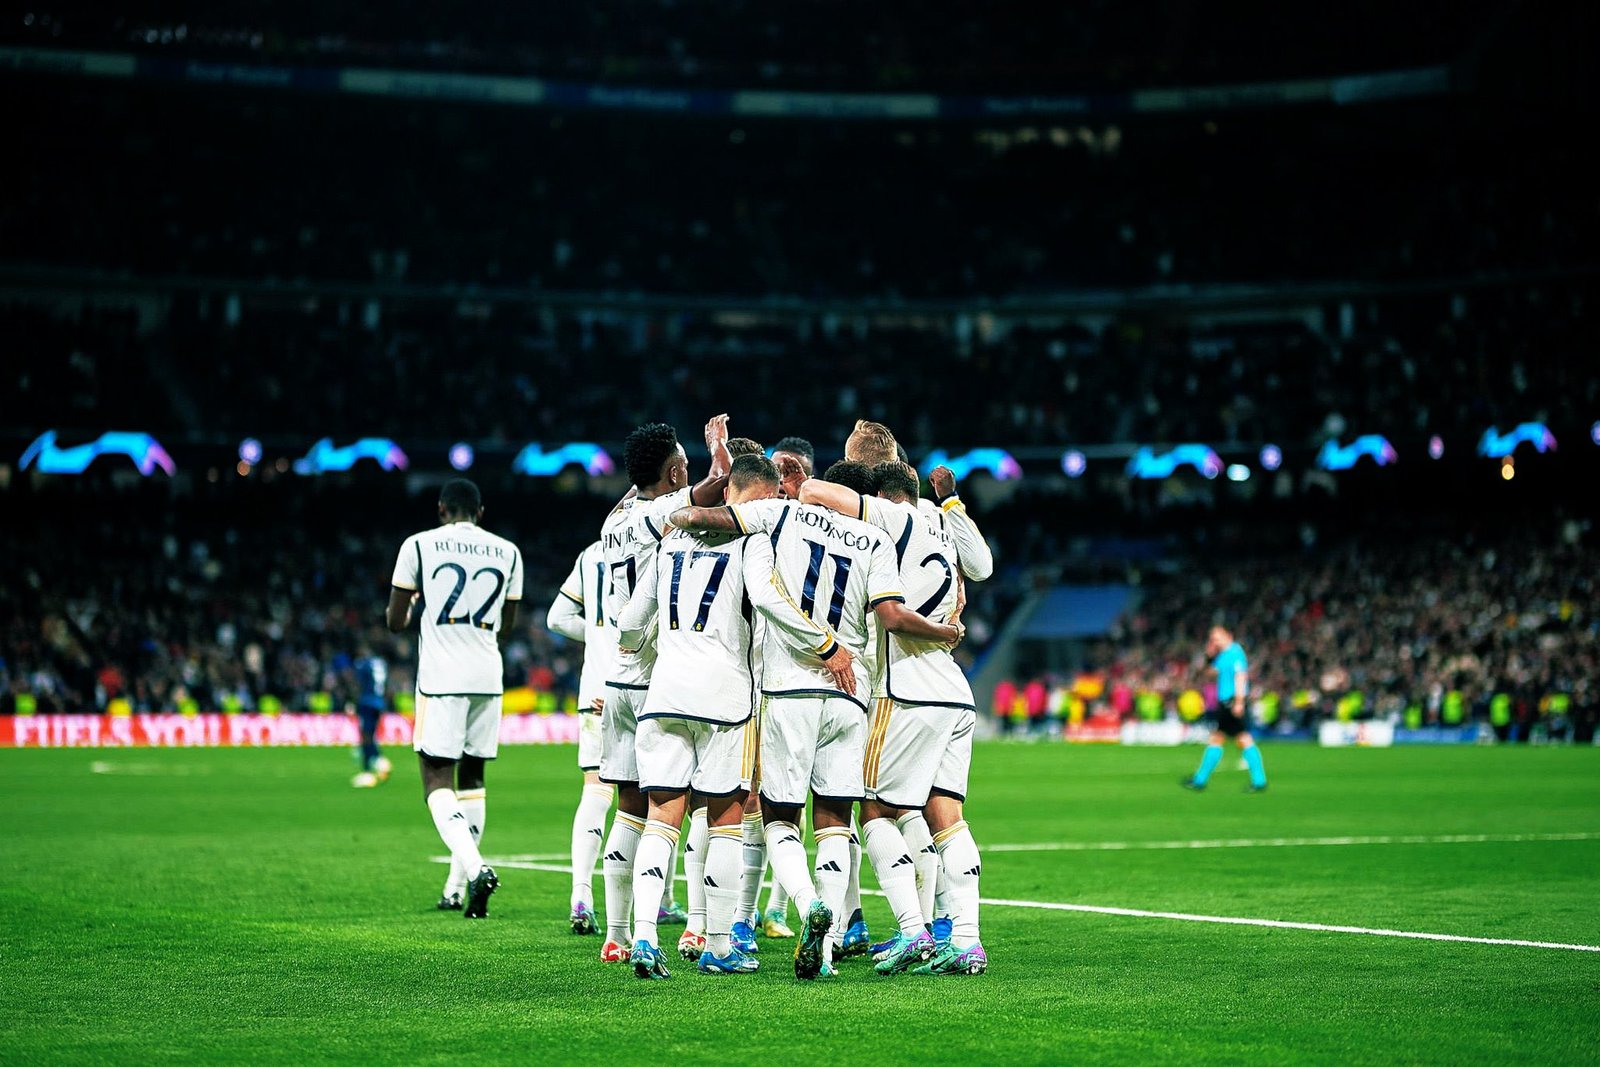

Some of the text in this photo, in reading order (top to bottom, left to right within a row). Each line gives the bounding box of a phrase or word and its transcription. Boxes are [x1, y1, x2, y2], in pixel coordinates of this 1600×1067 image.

[434, 538, 504, 559] RÜDIGER
[800, 537, 853, 633] 11
[431, 562, 506, 632] 22
[666, 550, 731, 633] 17
